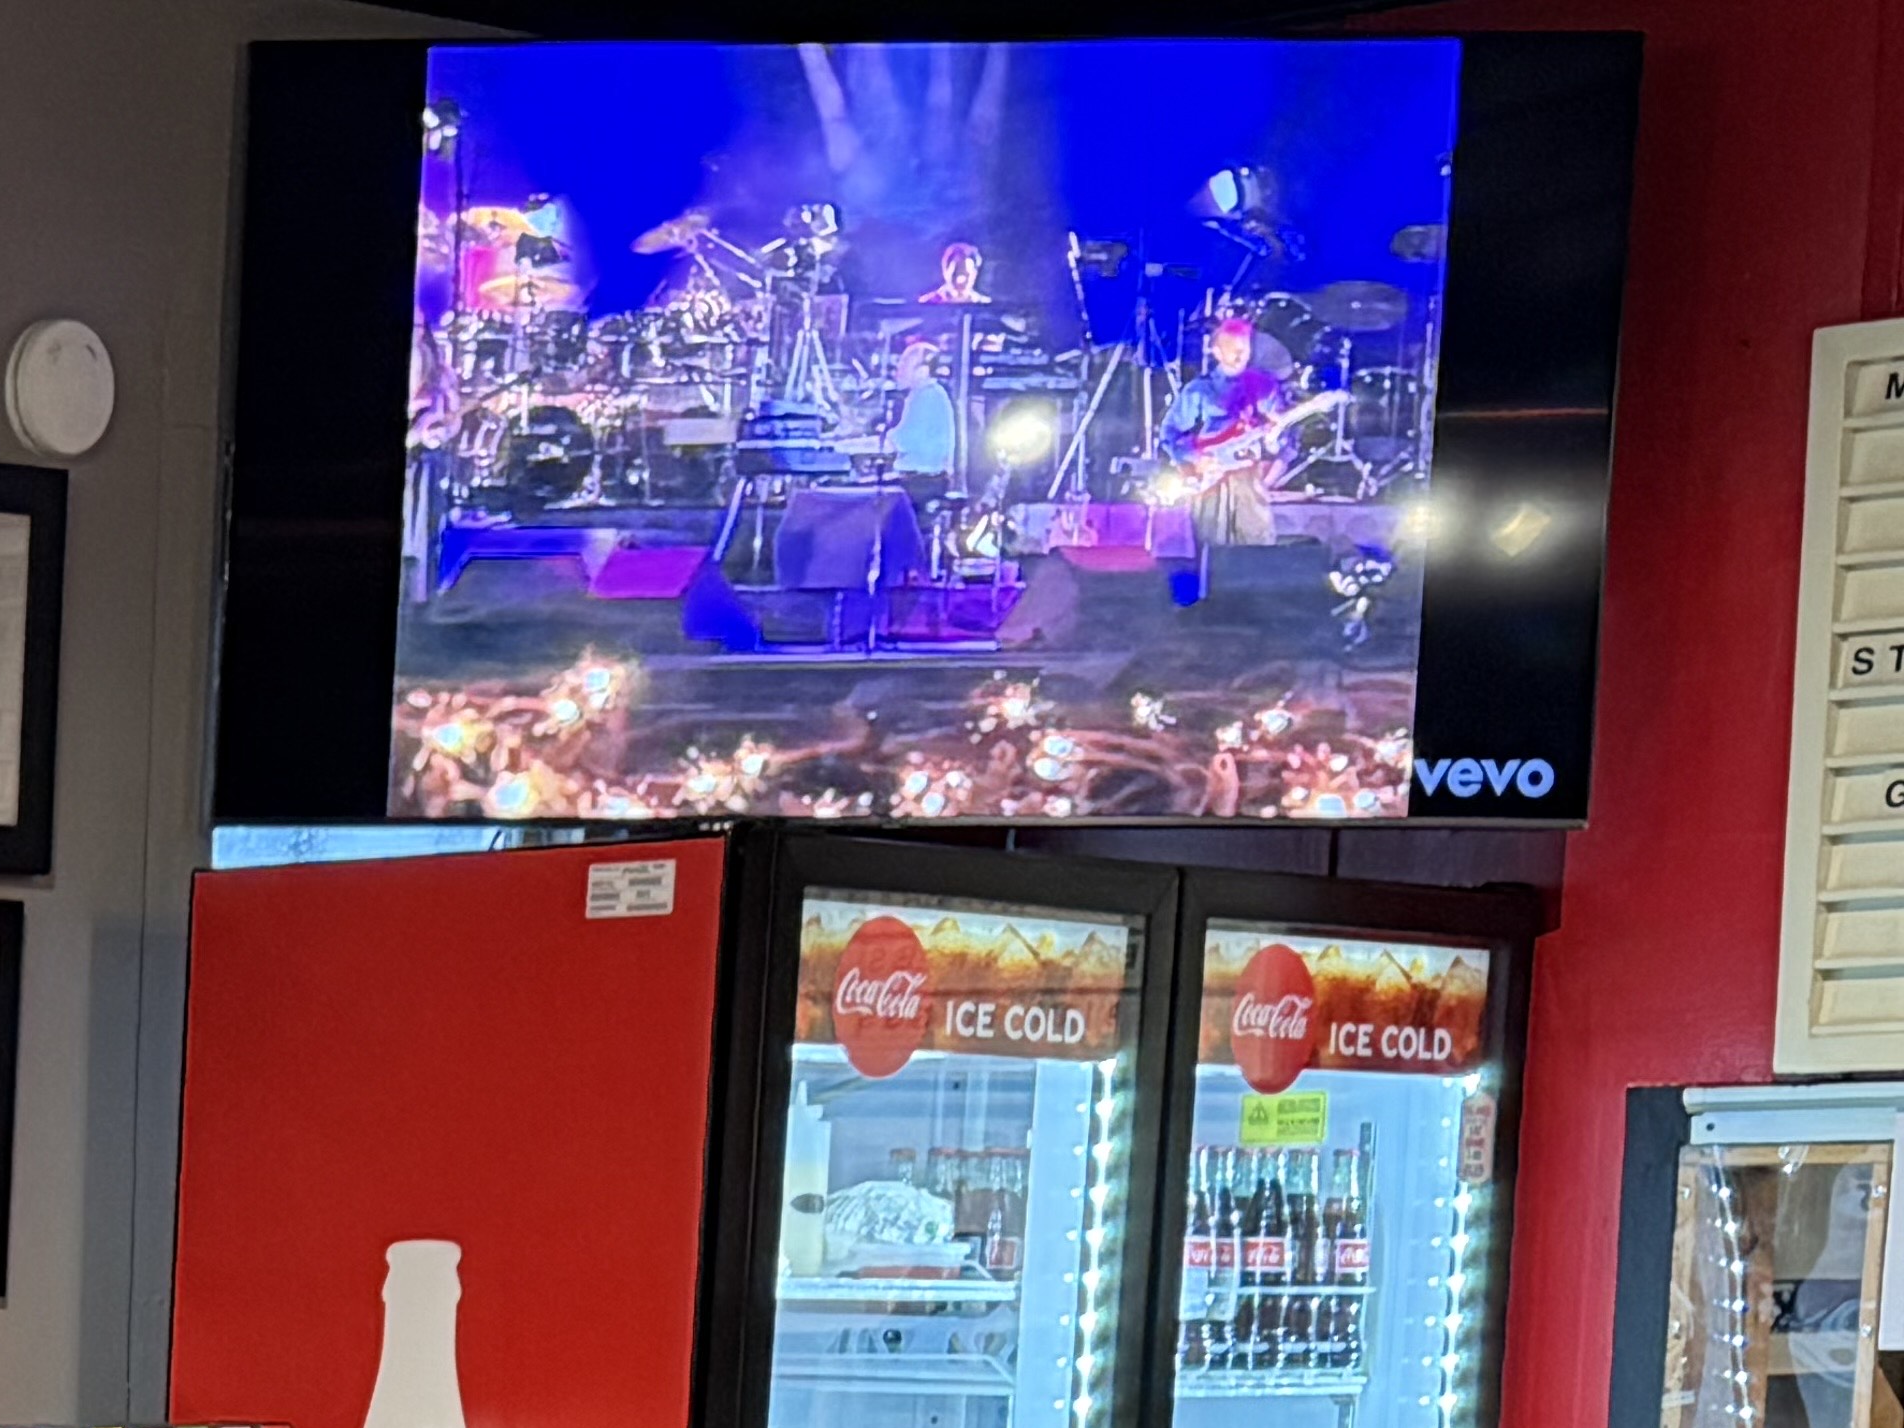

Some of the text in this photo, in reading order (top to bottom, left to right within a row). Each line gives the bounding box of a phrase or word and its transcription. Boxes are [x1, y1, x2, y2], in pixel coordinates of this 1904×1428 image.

[1413, 757, 1555, 798] vevo
[946, 1000, 1085, 1044] ICE COLD
[1329, 1022, 1452, 1061] ICE COLD
